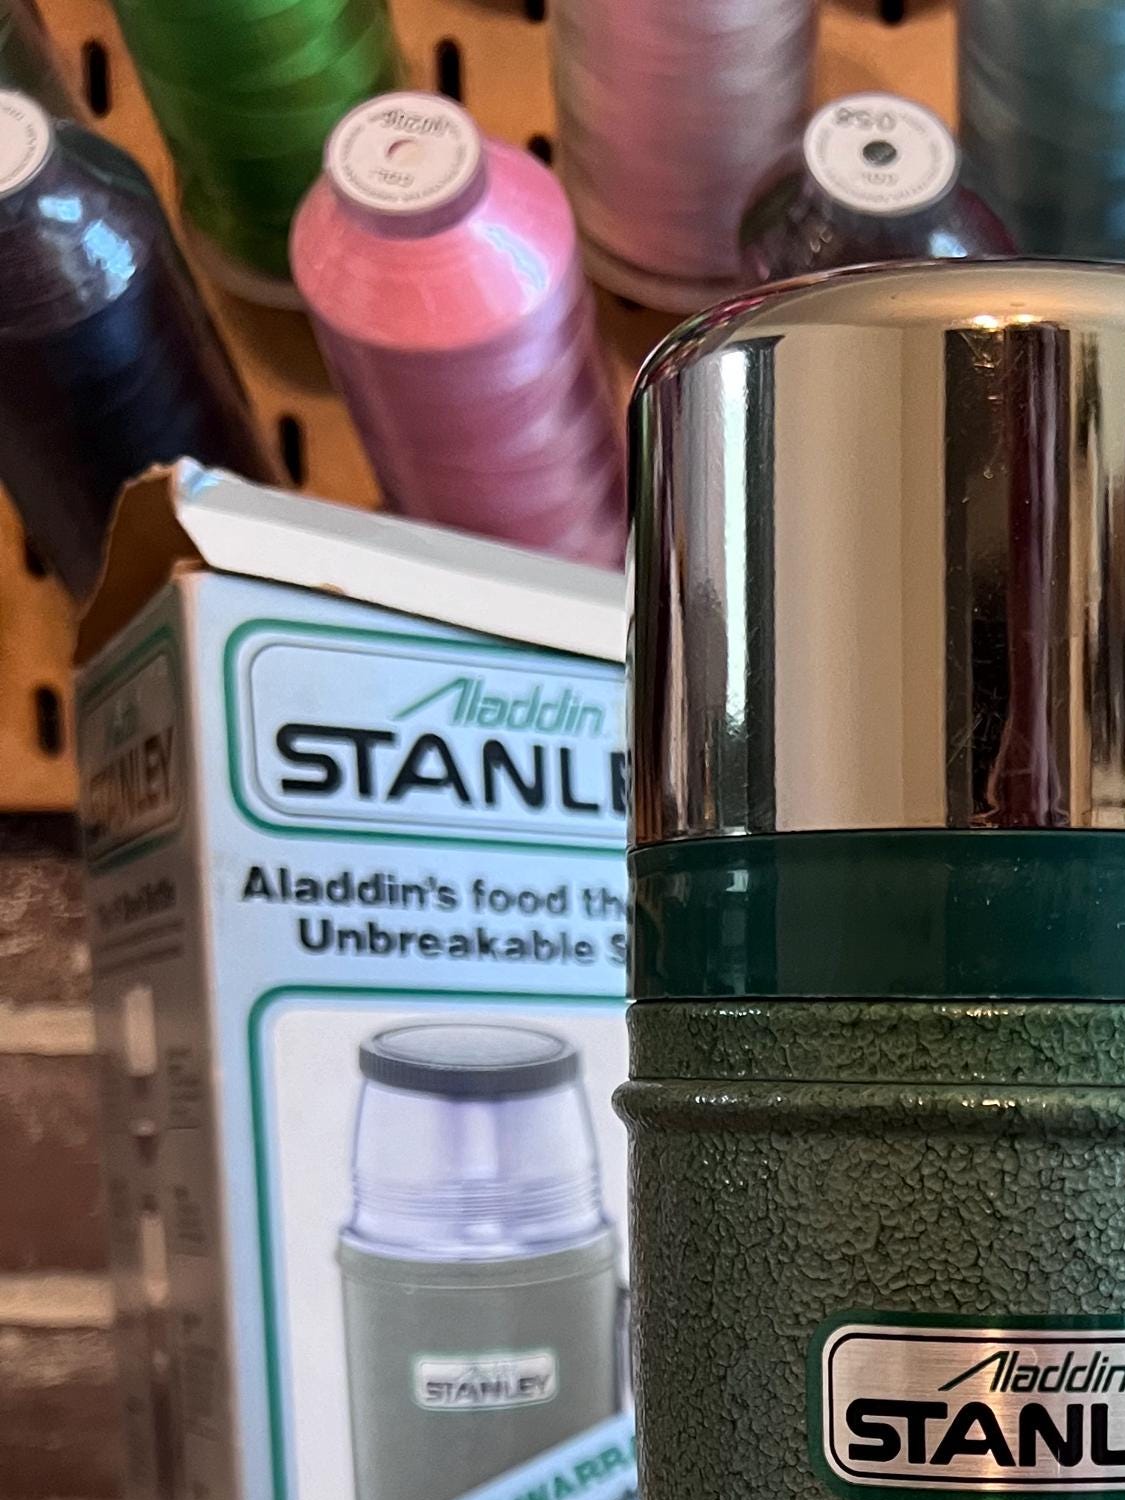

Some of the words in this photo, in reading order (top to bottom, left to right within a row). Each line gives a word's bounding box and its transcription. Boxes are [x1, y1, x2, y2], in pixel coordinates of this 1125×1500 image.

[391, 675, 604, 735] Aladdin
[242, 866, 457, 911] Aladdin's
[473, 878, 568, 917] food
[299, 917, 596, 963] Unbreakable
[426, 1371, 551, 1403] STANLEY
